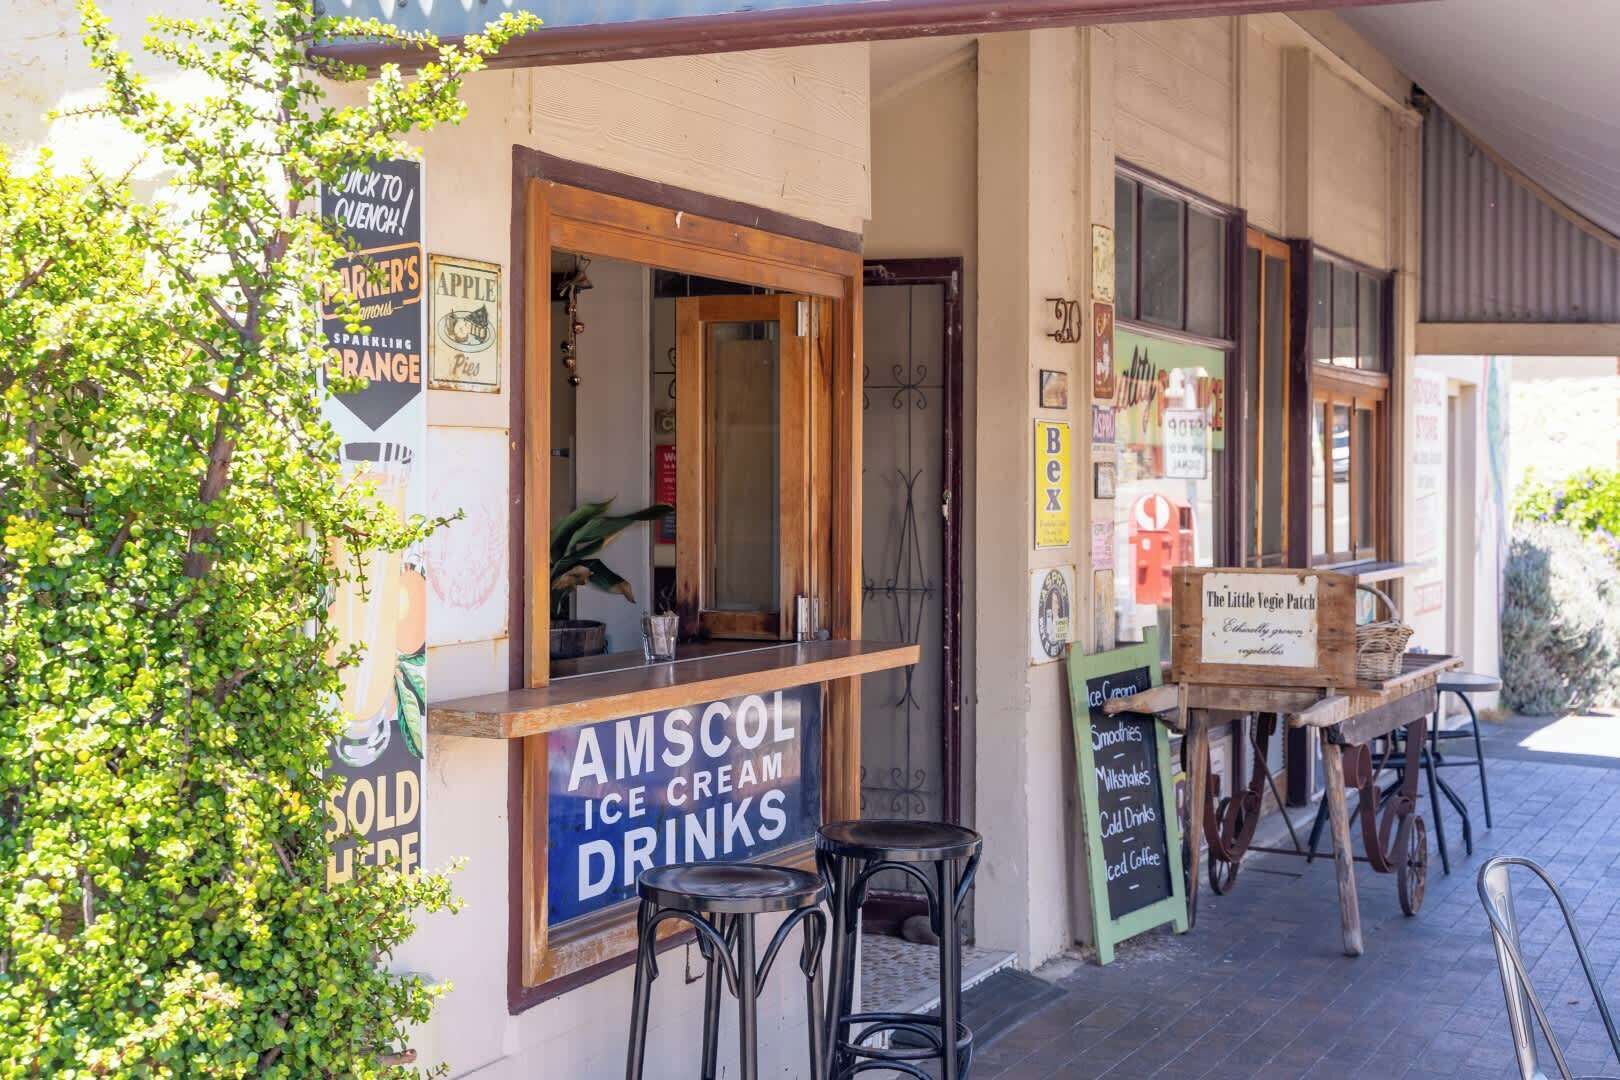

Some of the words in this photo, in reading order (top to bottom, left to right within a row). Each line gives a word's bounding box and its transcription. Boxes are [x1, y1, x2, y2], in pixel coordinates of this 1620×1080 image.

[382, 174, 403, 202] TO
[334, 188, 414, 236] QUENCH!
[436, 271, 496, 303] APPLE
[333, 332, 412, 350] SPARKLING
[451, 353, 481, 376] Pies
[1045, 426, 1062, 512] Bex
[1207, 591, 1224, 608] The
[1227, 591, 1255, 609] Little
[1257, 592, 1284, 612] Vegie
[1287, 593, 1316, 610] Patch
[1238, 643, 1284, 658] vegetables
[567, 690, 795, 792] AMSCOL
[1090, 721, 1143, 751] Smoothies
[325, 769, 420, 844] SOLD
[584, 786, 646, 831] ICE
[666, 752, 783, 807] CREAM
[1100, 809, 1123, 838] Cold
[1124, 804, 1156, 829] Drinks
[578, 789, 787, 902] DRINKS
[1104, 851, 1128, 881] Iced
[1129, 846, 1161, 871] Coffee
